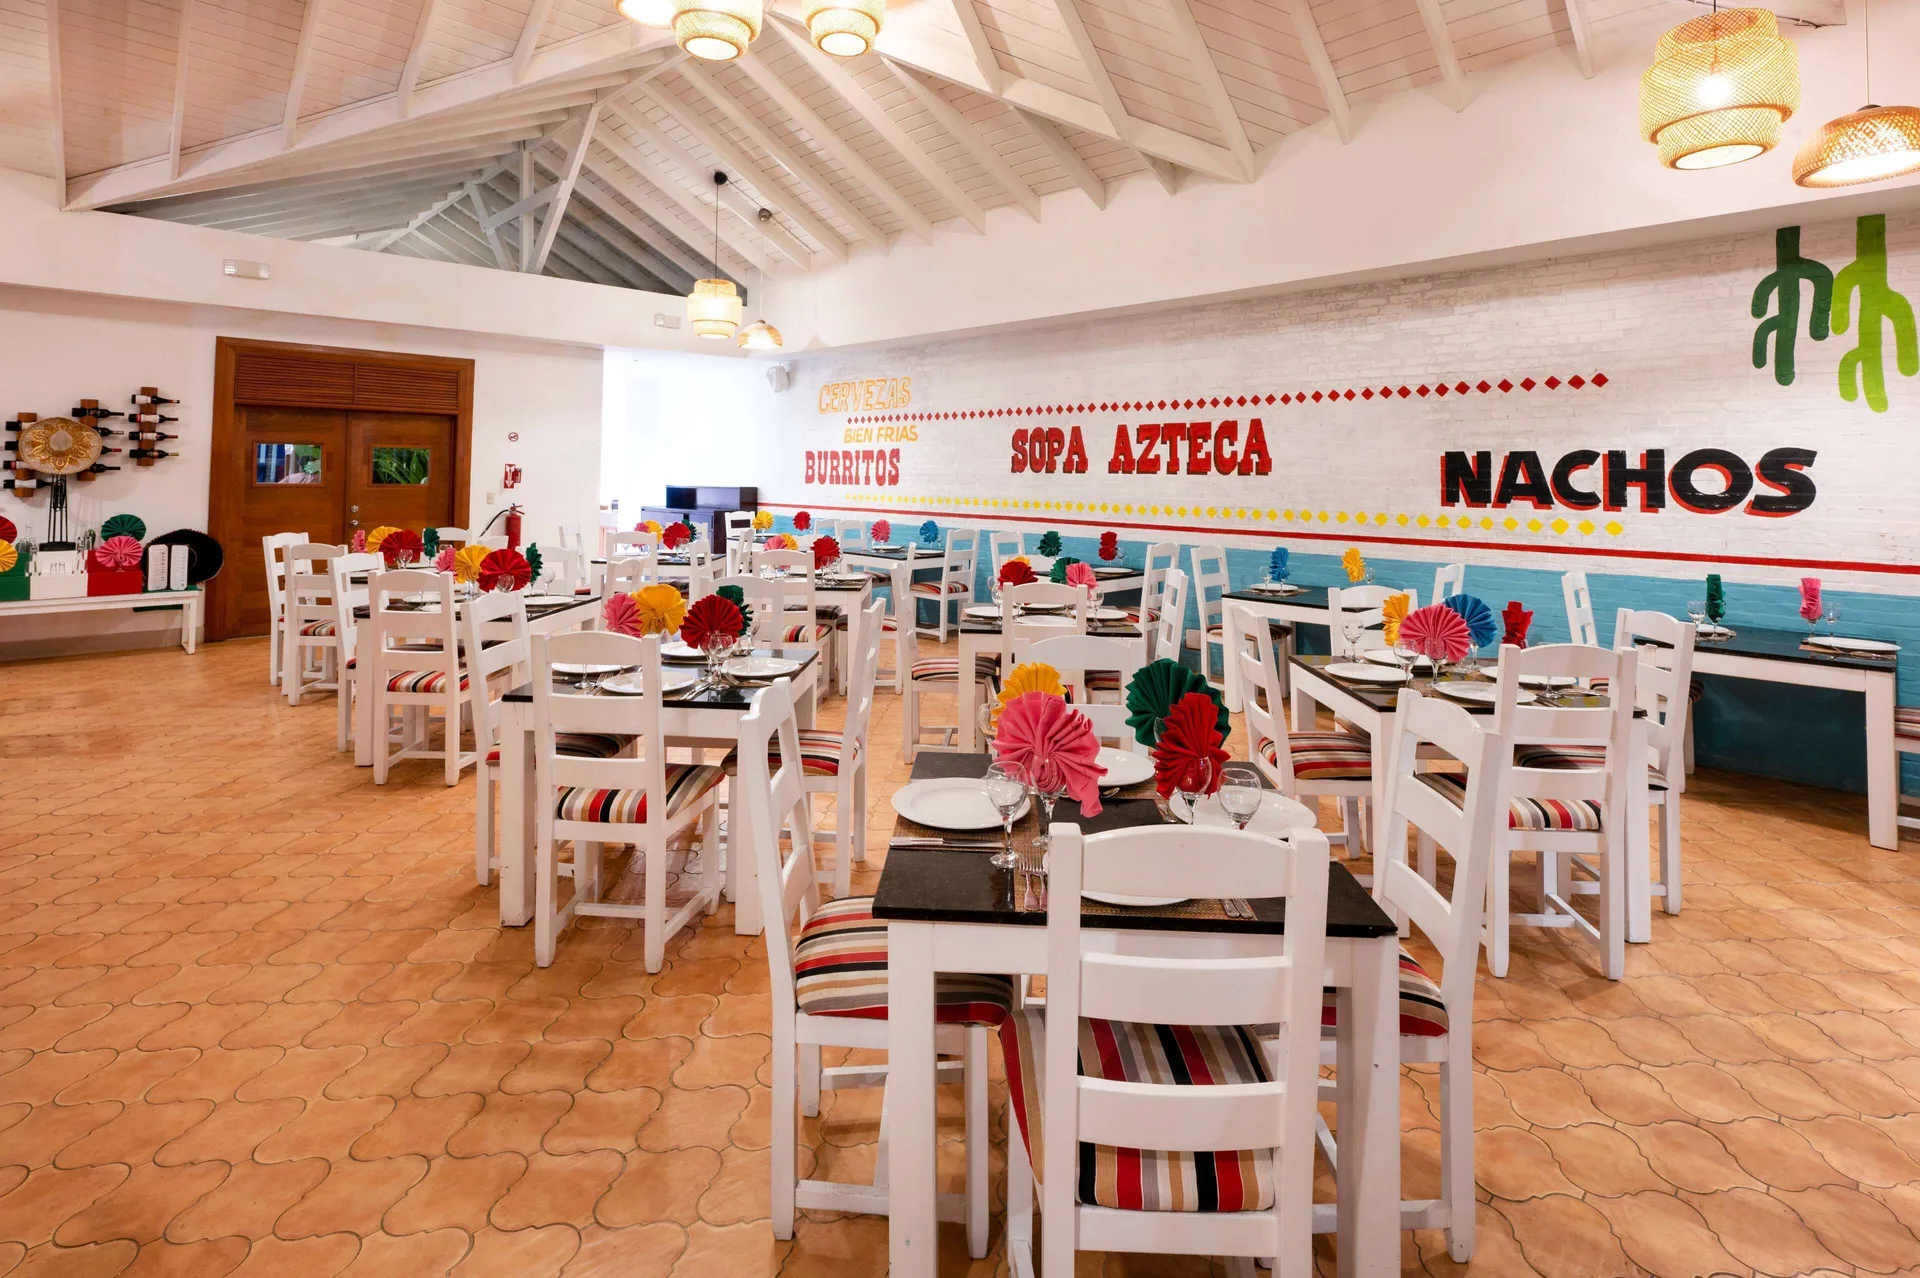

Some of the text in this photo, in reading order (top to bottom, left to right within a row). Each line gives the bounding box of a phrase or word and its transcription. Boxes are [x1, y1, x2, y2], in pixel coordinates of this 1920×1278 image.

[818, 376, 911, 415] CERVEZAS
[844, 424, 918, 443] BIEN FRIAS
[1011, 418, 1272, 476] SOPA AZTECA
[805, 448, 900, 486] BURRITOS
[1441, 448, 1818, 517] NACHOS
